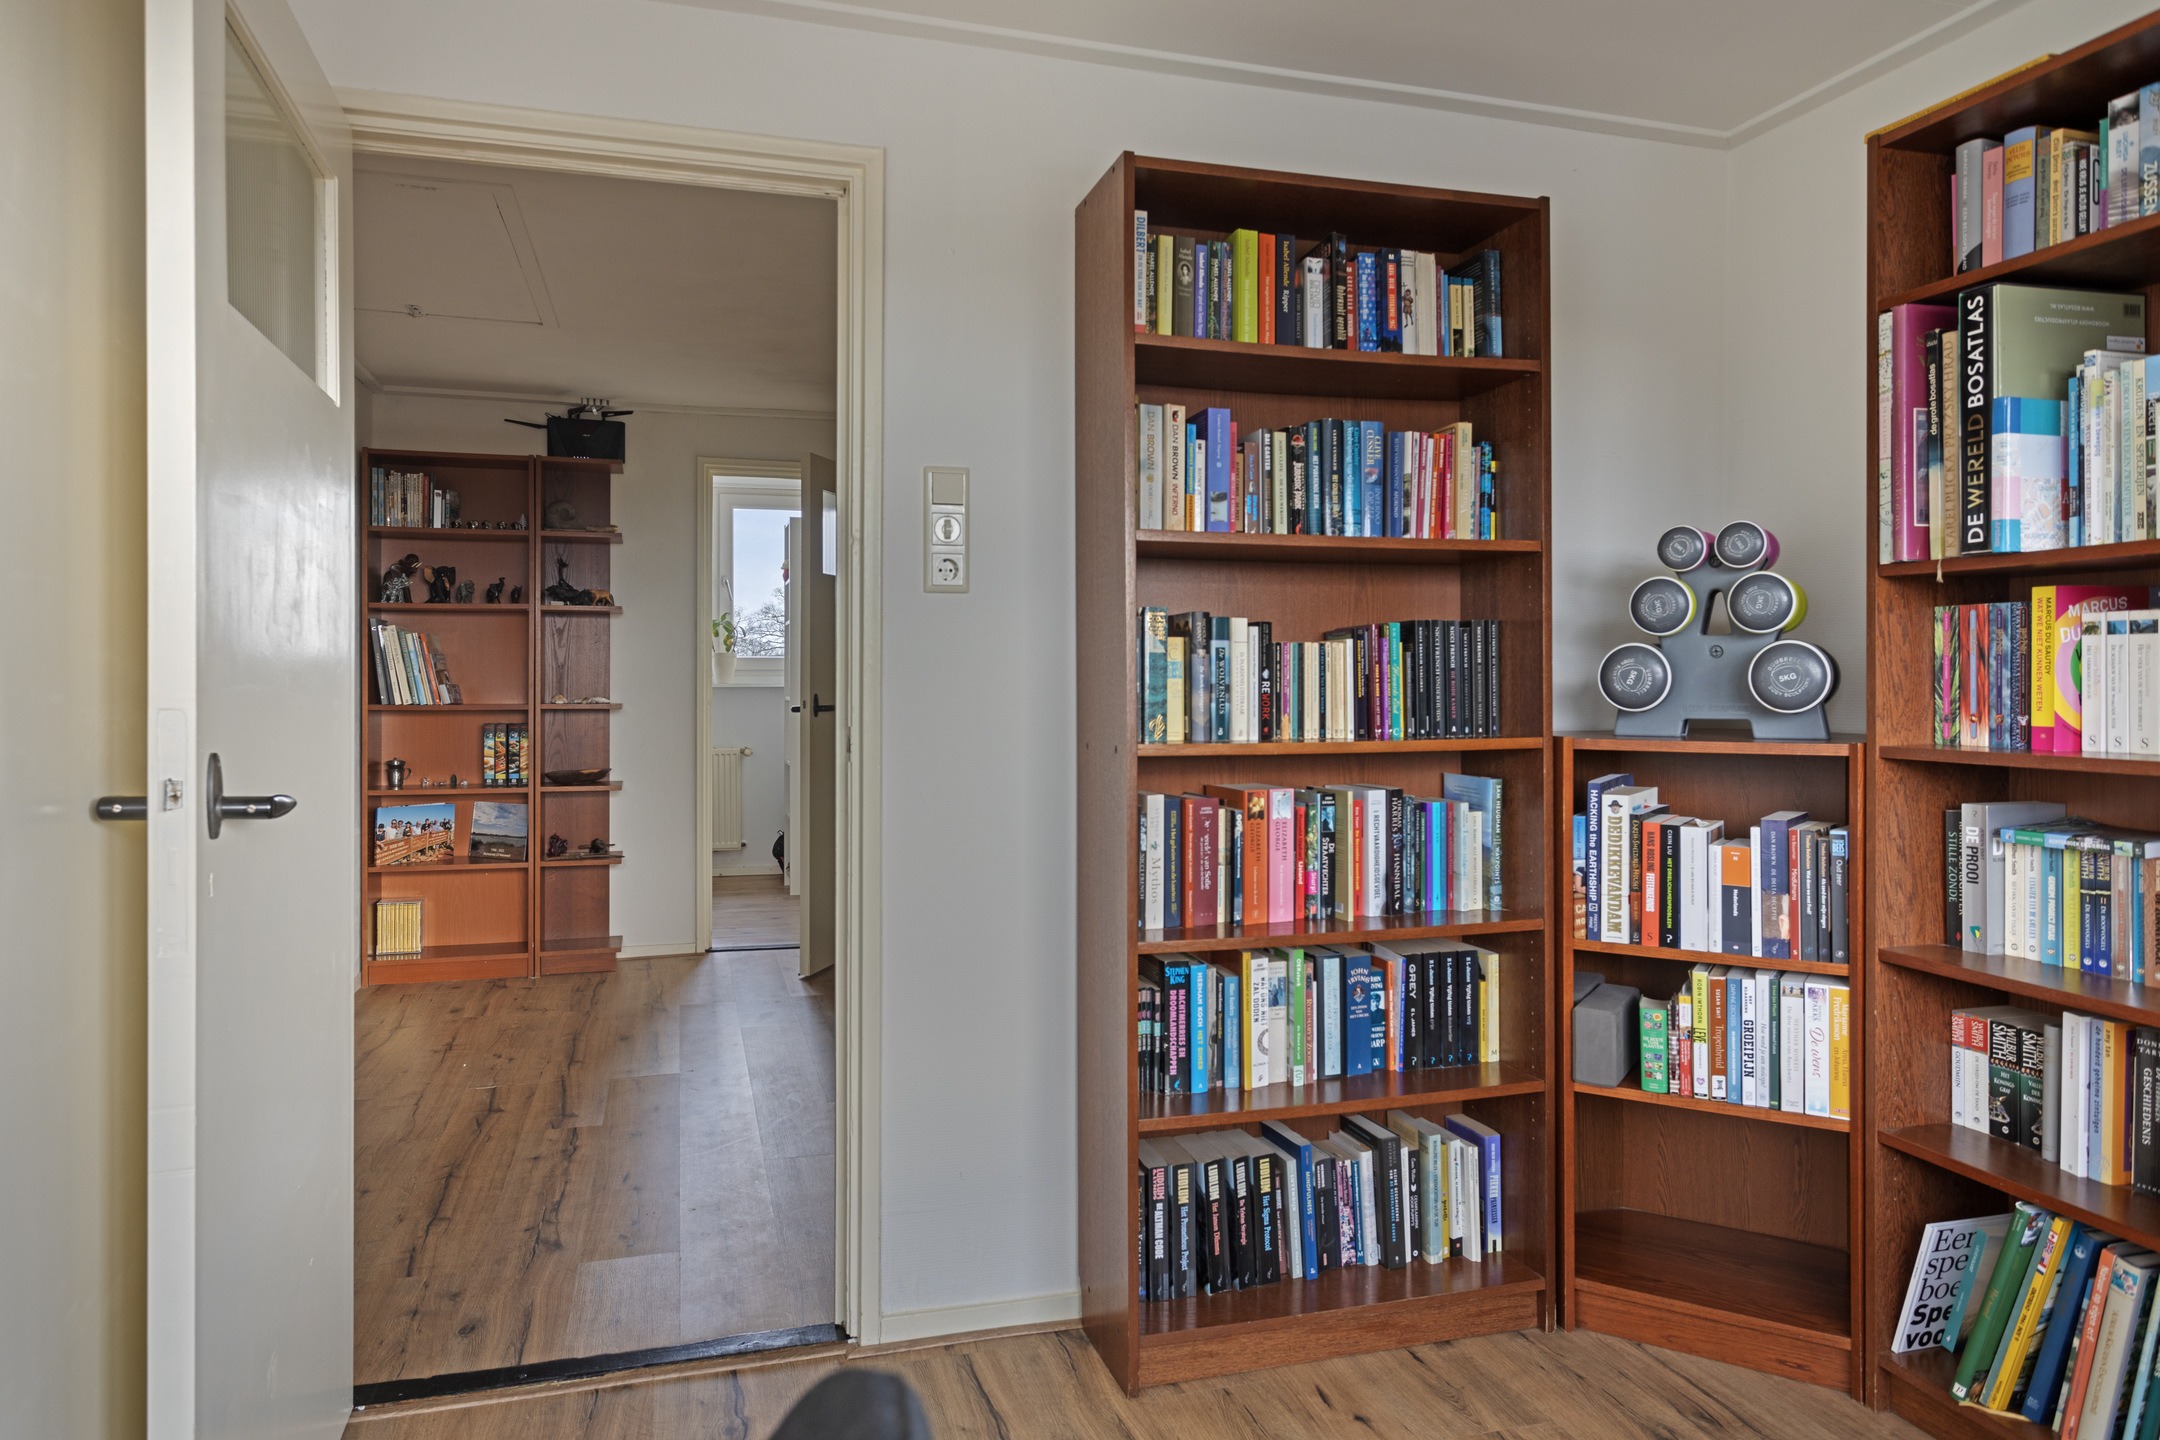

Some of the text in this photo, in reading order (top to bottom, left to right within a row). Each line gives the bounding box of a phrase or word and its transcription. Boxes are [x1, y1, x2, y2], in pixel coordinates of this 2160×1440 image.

[1136, 217, 1146, 254] DILBERT
[1928, 364, 1938, 435] de grote bosatlas
[1967, 294, 1985, 544] DE WERELD BOSATLAS
[2135, 377, 2145, 497] KRUIDEN EN SPECERIJEN
[1366, 430, 1374, 465] CUSSLER
[1943, 339, 1956, 549] KAREL PLICKA HRAD
[2122, 410, 2132, 517] VAN EEN EIGEN ZWEMVIJVER
[1653, 600, 1664, 614] 3KG
[2037, 615, 2043, 627] WE
[2068, 596, 2127, 618] MARCUS
[1219, 648, 1225, 658] De
[2046, 632, 2052, 643] DU
[2060, 626, 2082, 644] DU
[1626, 669, 1638, 685] 5KG
[1779, 672, 1797, 682] 5KG
[1262, 681, 1270, 720] REWORK
[1589, 790, 1598, 901] HACKING the EARTHSHIP
[1949, 831, 1957, 863] STILLE
[1966, 826, 1979, 884] DE PROOI
[1151, 857, 1161, 904] Mythos
[1607, 816, 1623, 933] DEDIKKEVANDAM
[1646, 832, 1655, 912] HANS ROSLING FEITENKENNIS
[1949, 866, 1957, 903] ZONDE
[1169, 989, 1177, 1075] DROOMLANDSCHAPPEN
[1178, 989, 1186, 1058] NACHTMERRIES EN
[1693, 1028, 1706, 1043] LEVE
[1833, 996, 1841, 1040] Fredriksson
[2096, 1026, 2101, 1035] de
[1713, 1025, 1724, 1069] Tropenbruid
[1744, 1020, 1754, 1078] GROEIPIJN
[1809, 1027, 1824, 1078] De wens
[1992, 1023, 2006, 1060] SMITH
[2006, 1028, 2016, 1062] WILBUR
[2022, 1032, 2036, 1068] SMITH
[2000, 1071, 2010, 1079] HET
[2142, 1068, 2152, 1145] GESCHIEDENIS
[1156, 1168, 1165, 1200] LUDLUM
[1177, 1168, 1189, 1204] LUDLUM
[1208, 1164, 1220, 1200] LUDLUM
[1236, 1162, 1246, 1198] LUDLUM
[1259, 1158, 1270, 1193] LUDLUM
[1154, 1202, 1164, 1259] DE ALTMAN CODE
[1264, 1226, 1272, 1251] Protocol
[1180, 1251, 1189, 1270] Project
[1925, 1254, 1969, 1280] spe
[2086, 1293, 2103, 1343] op eigen erf
